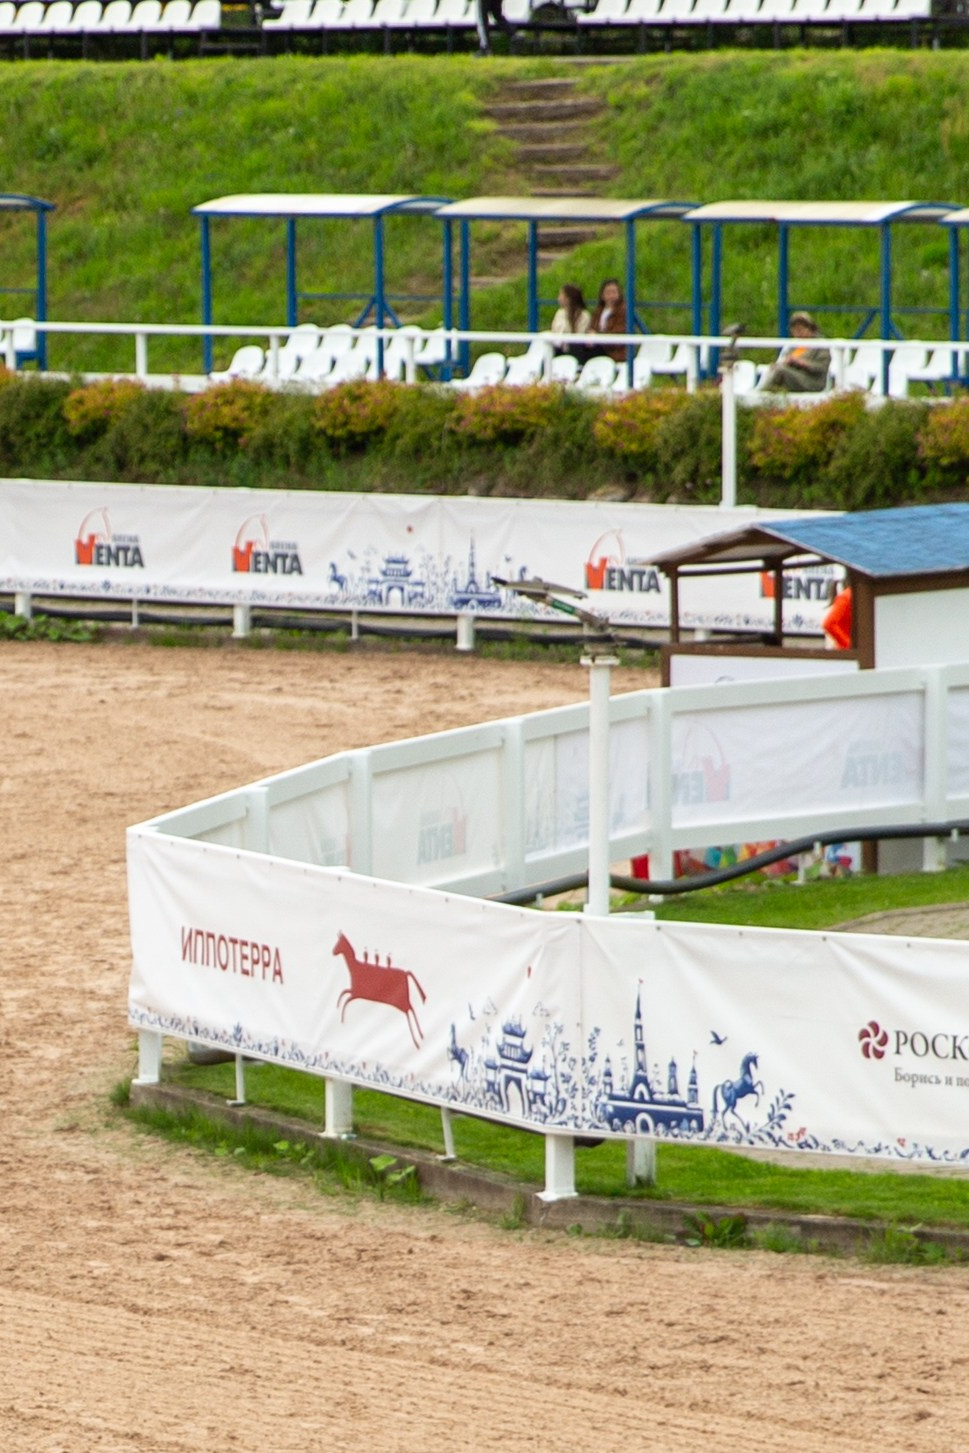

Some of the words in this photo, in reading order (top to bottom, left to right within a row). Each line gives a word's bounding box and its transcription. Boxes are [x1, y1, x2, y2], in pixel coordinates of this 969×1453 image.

[75, 533, 144, 568] VENTA
[232, 541, 303, 575] VENTA
[585, 556, 661, 594] VENTA
[181, 925, 284, 985] ИППОТЕРРА
[894, 1066, 941, 1088] Борись
[945, 1076, 953, 1086] и
